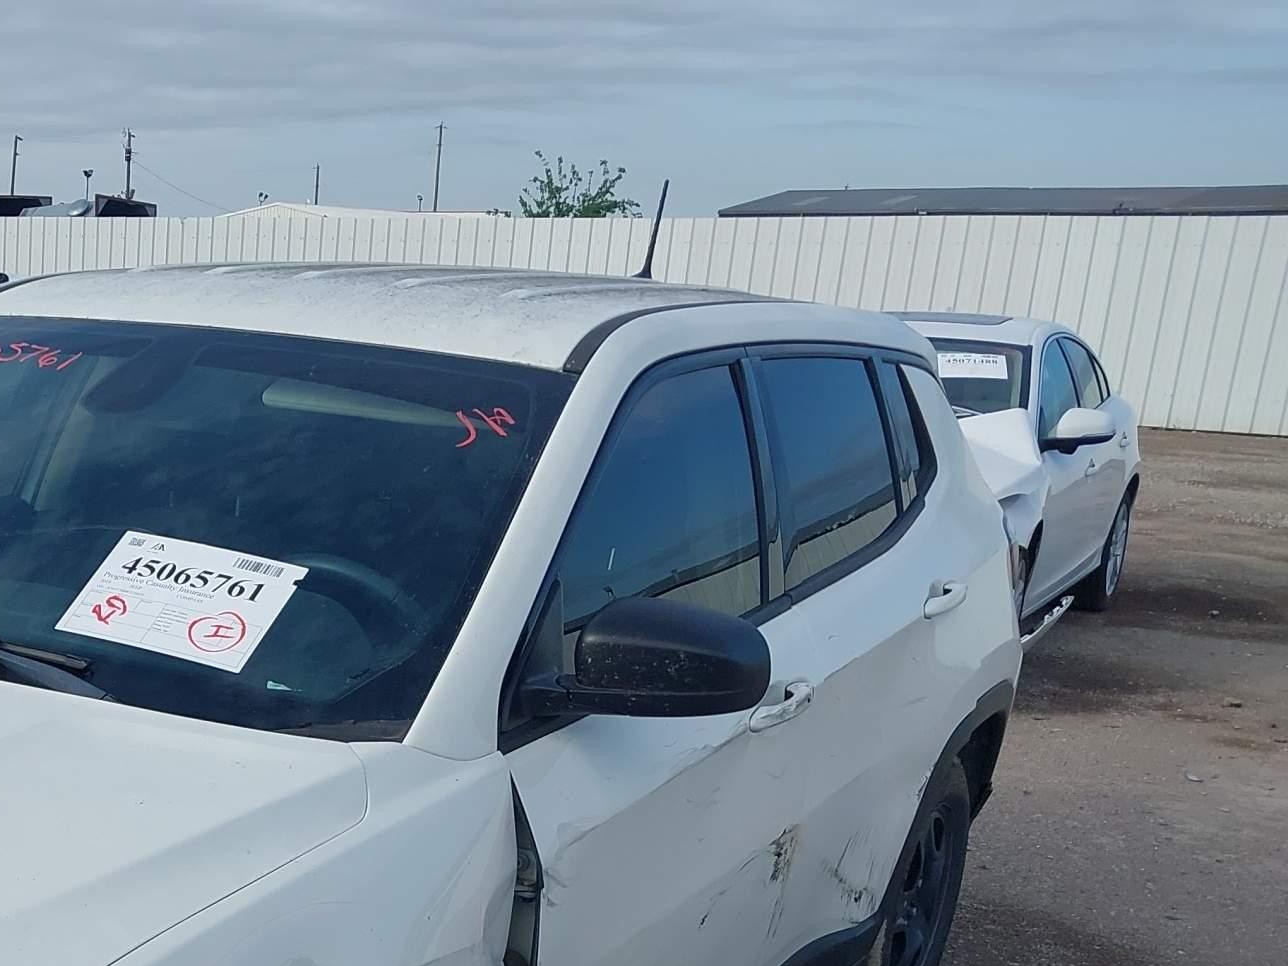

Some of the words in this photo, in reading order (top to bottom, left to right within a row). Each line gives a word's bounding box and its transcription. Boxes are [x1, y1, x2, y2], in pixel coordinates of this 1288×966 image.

[103, 571, 145, 585] Progressive
[145, 580, 177, 592] Casualty
[179, 586, 215, 600] Insurance
[121, 556, 266, 603] 45065761
